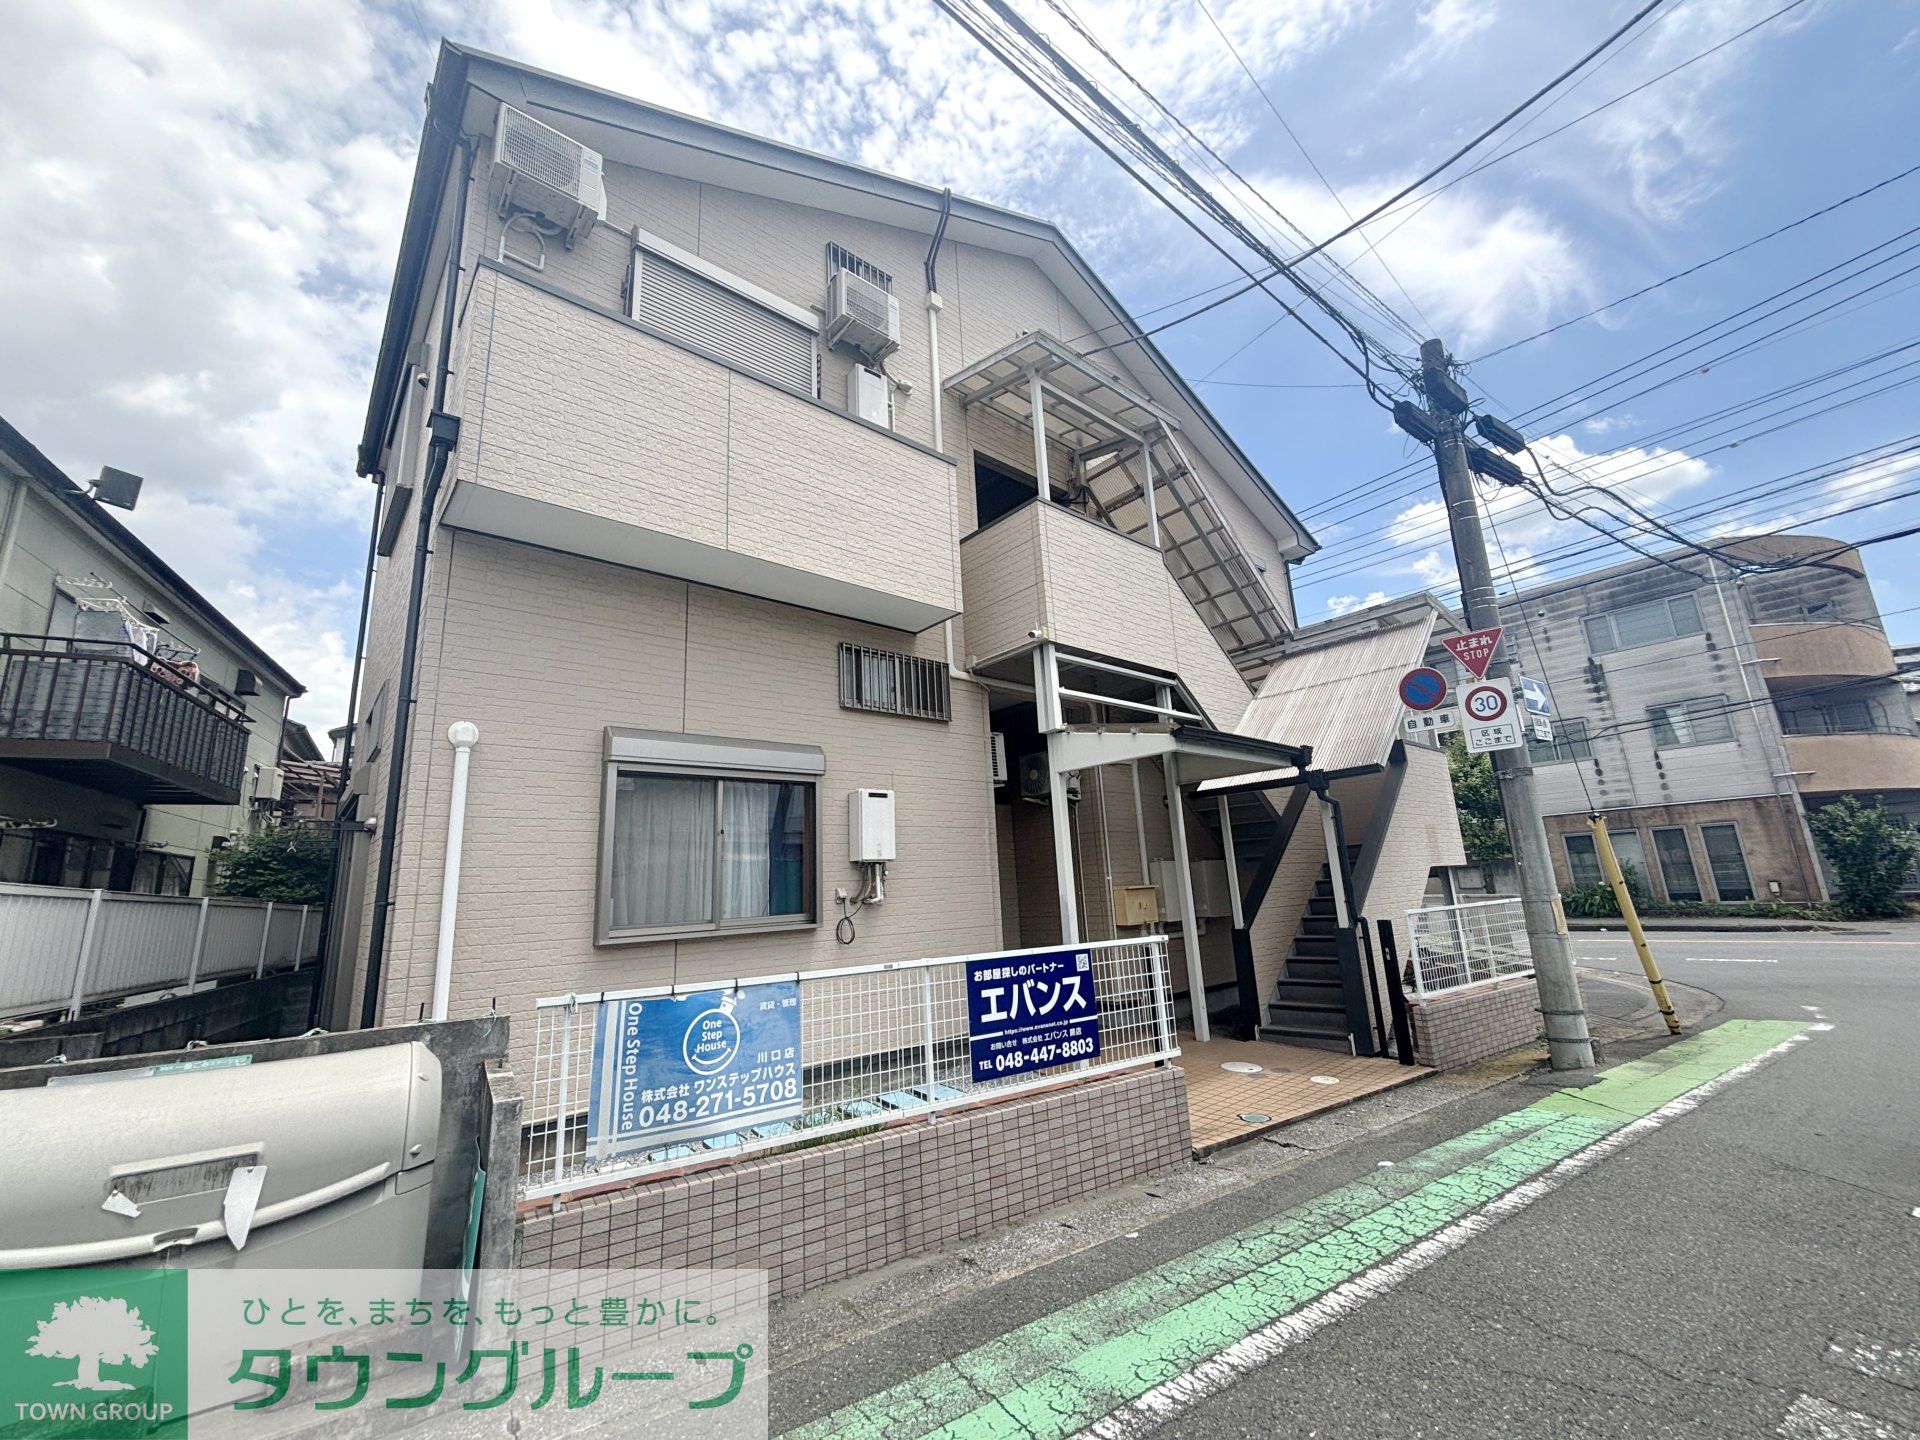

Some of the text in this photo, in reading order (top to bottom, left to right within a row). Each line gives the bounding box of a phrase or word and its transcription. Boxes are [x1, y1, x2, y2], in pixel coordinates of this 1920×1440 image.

[1456, 635, 1493, 652] 止まれ
[1463, 648, 1490, 661] STOP
[1474, 695, 1499, 713] 30
[1407, 714, 1450, 730] 自動車
[1481, 727, 1503, 737] 区域
[1475, 735, 1512, 747] ここまで
[973, 962, 1064, 982] お部屋探しのパートナー
[981, 975, 1087, 1023] エバンス
[702, 1019, 722, 1030] One
[702, 1030, 723, 1043] Step
[1022, 1034, 1044, 1045] 株式会社
[1044, 1029, 1069, 1042] エバンス
[697, 1039, 727, 1053] House
[979, 1037, 1094, 1072] TEL 048-447-8803
[757, 1047, 795, 1064] 川口店
[621, 1002, 643, 1131] One Step House
[641, 1062, 796, 1104] 株式会社 ワンステップハウス
[639, 1077, 797, 1128] 048-271-5708
